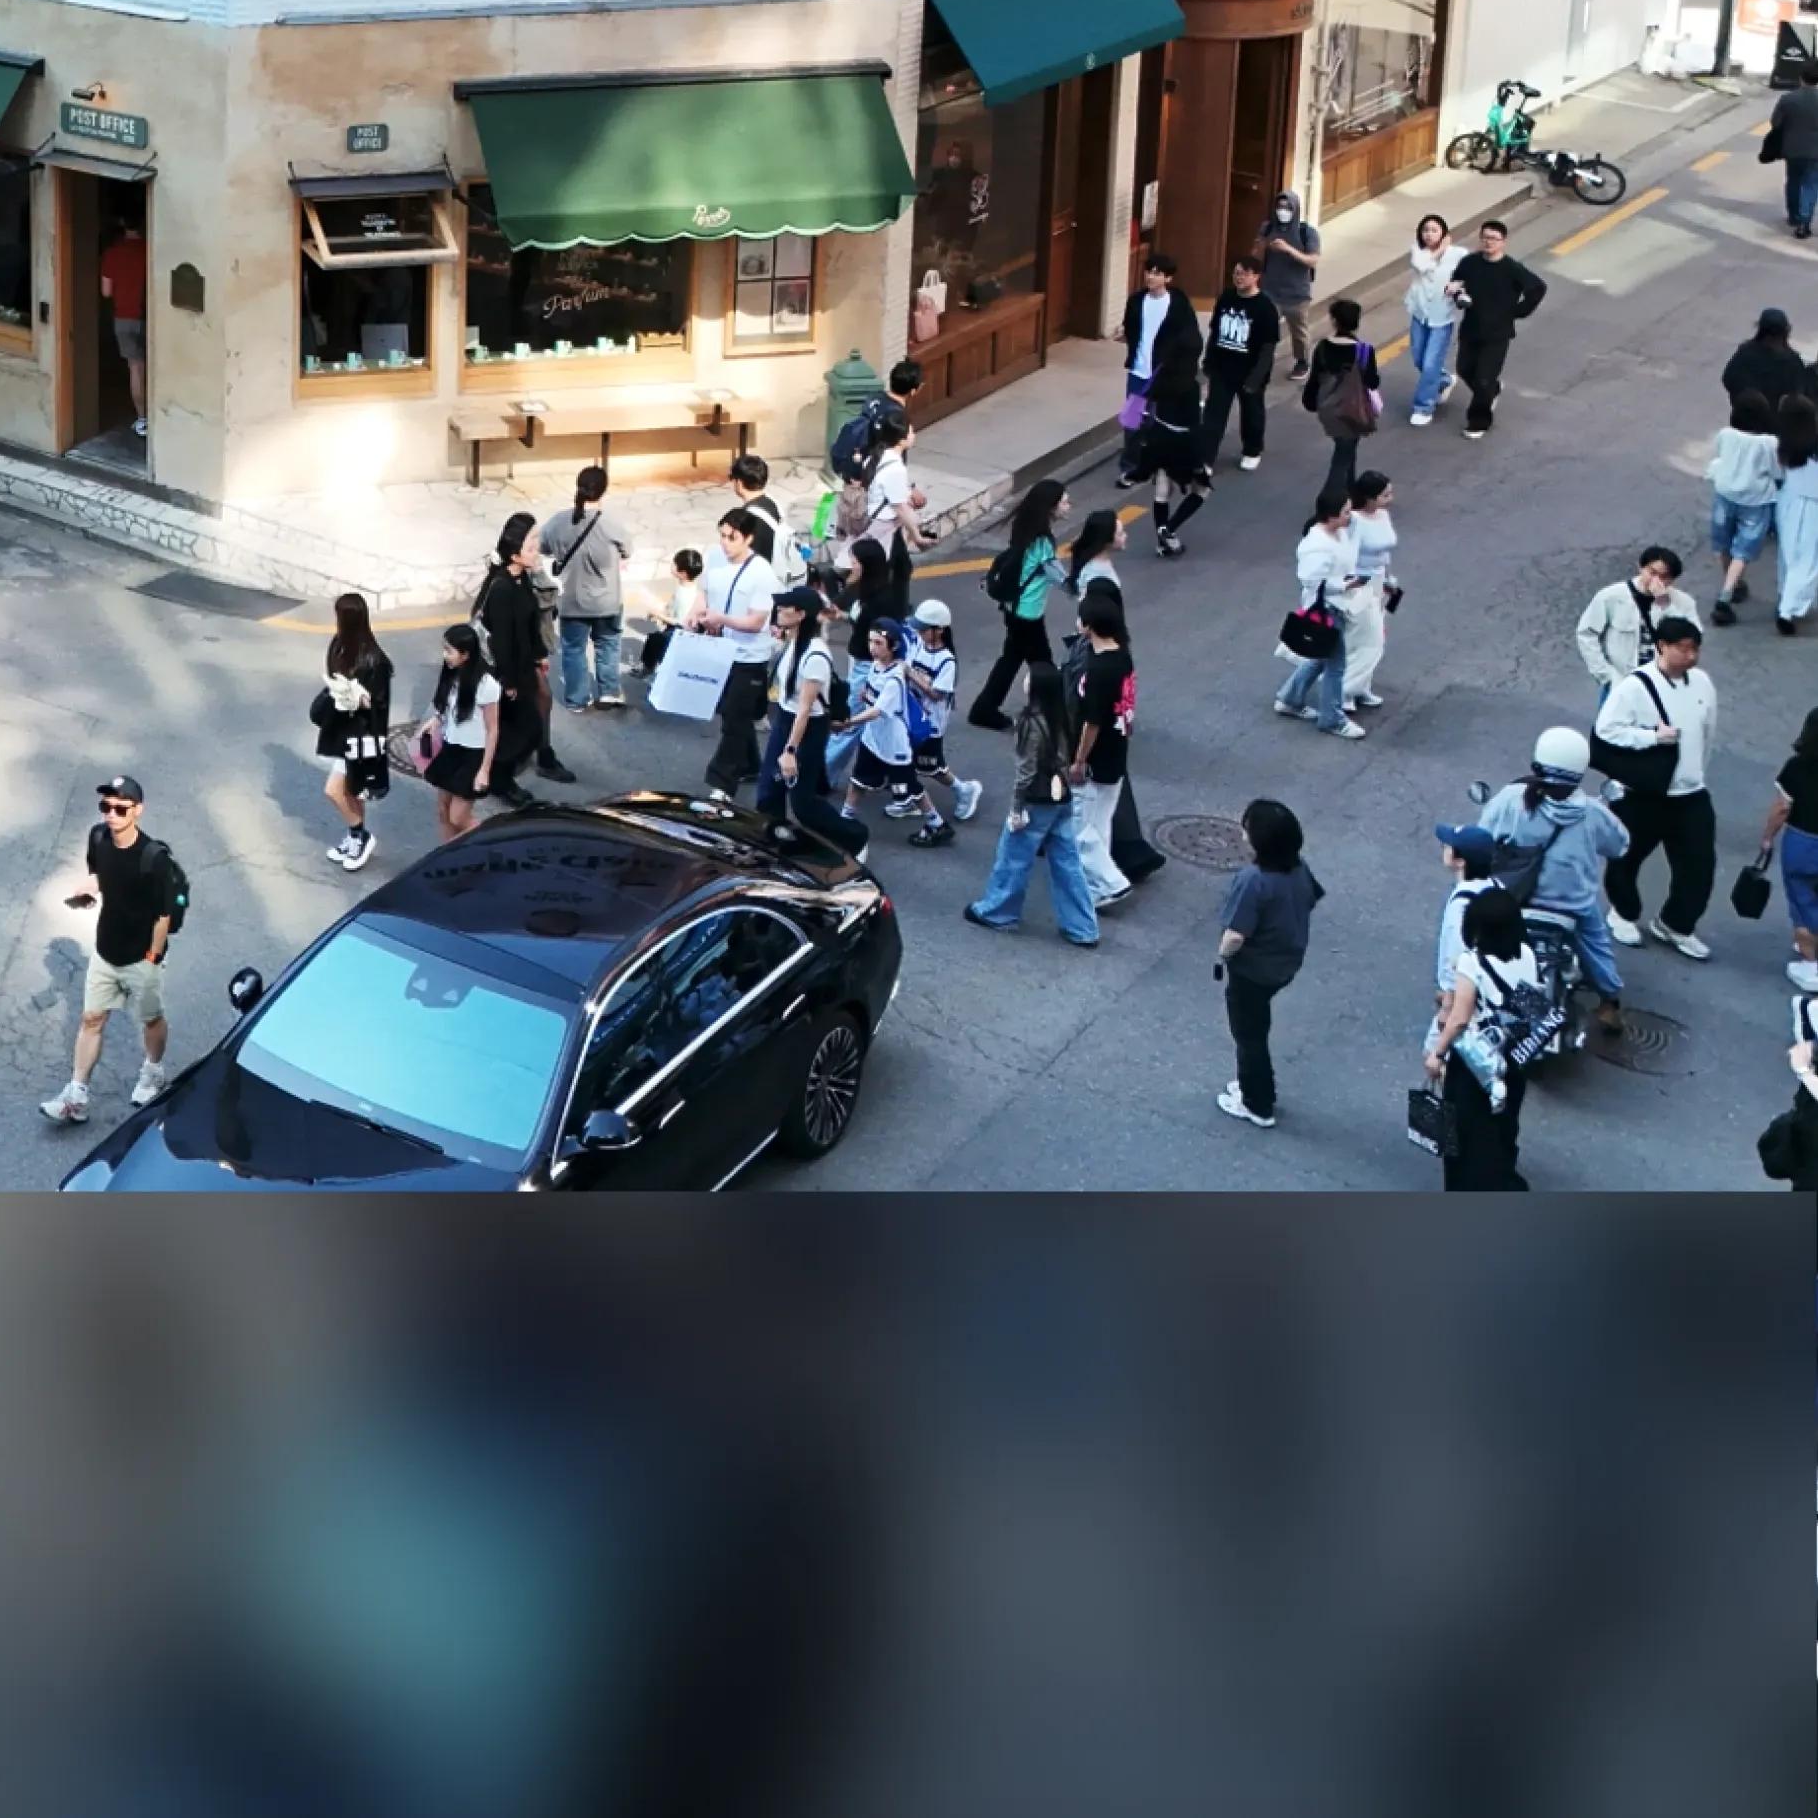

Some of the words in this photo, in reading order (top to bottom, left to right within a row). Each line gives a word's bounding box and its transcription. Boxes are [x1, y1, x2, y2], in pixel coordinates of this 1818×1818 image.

[70, 107, 97, 128] POST
[100, 111, 135, 135] OFFICE
[356, 127, 380, 137] POST
